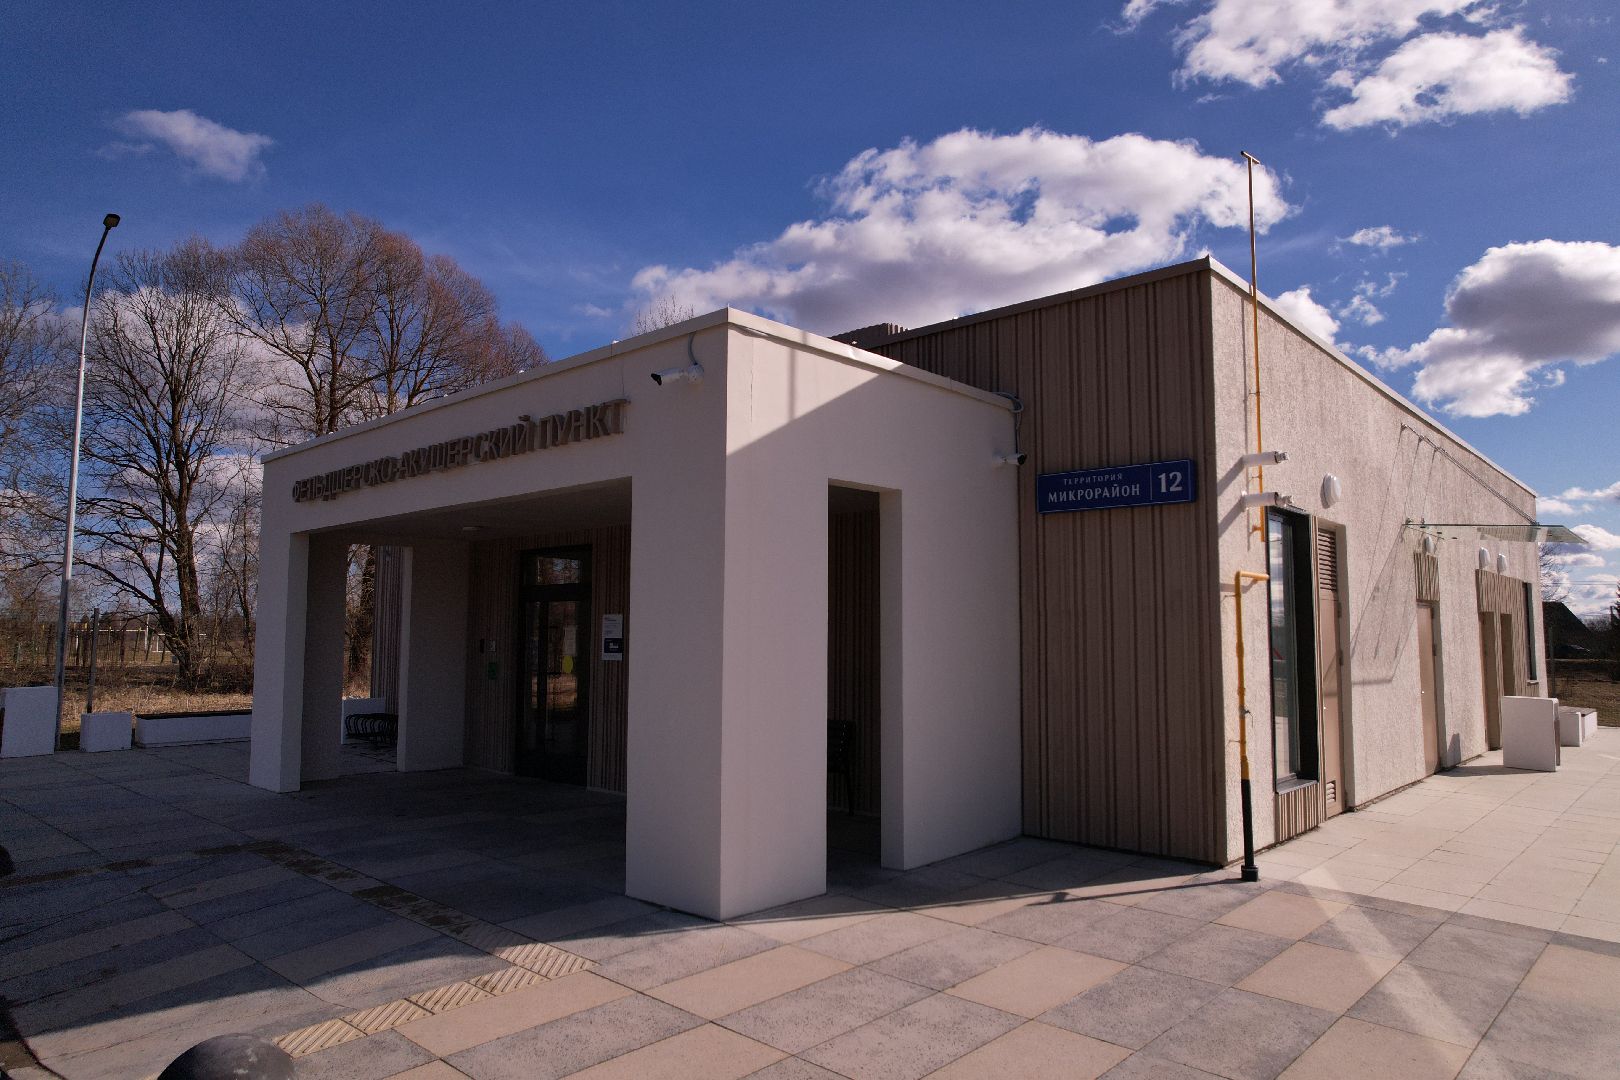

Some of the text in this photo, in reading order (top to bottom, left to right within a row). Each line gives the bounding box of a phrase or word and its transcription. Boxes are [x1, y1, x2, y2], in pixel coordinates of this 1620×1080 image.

[537, 399, 630, 449] ПУНКТ
[1048, 471, 1183, 503] МИКРОРАЙОН 12
[1064, 473, 1123, 485] ТЕРРИТОРИЯ
